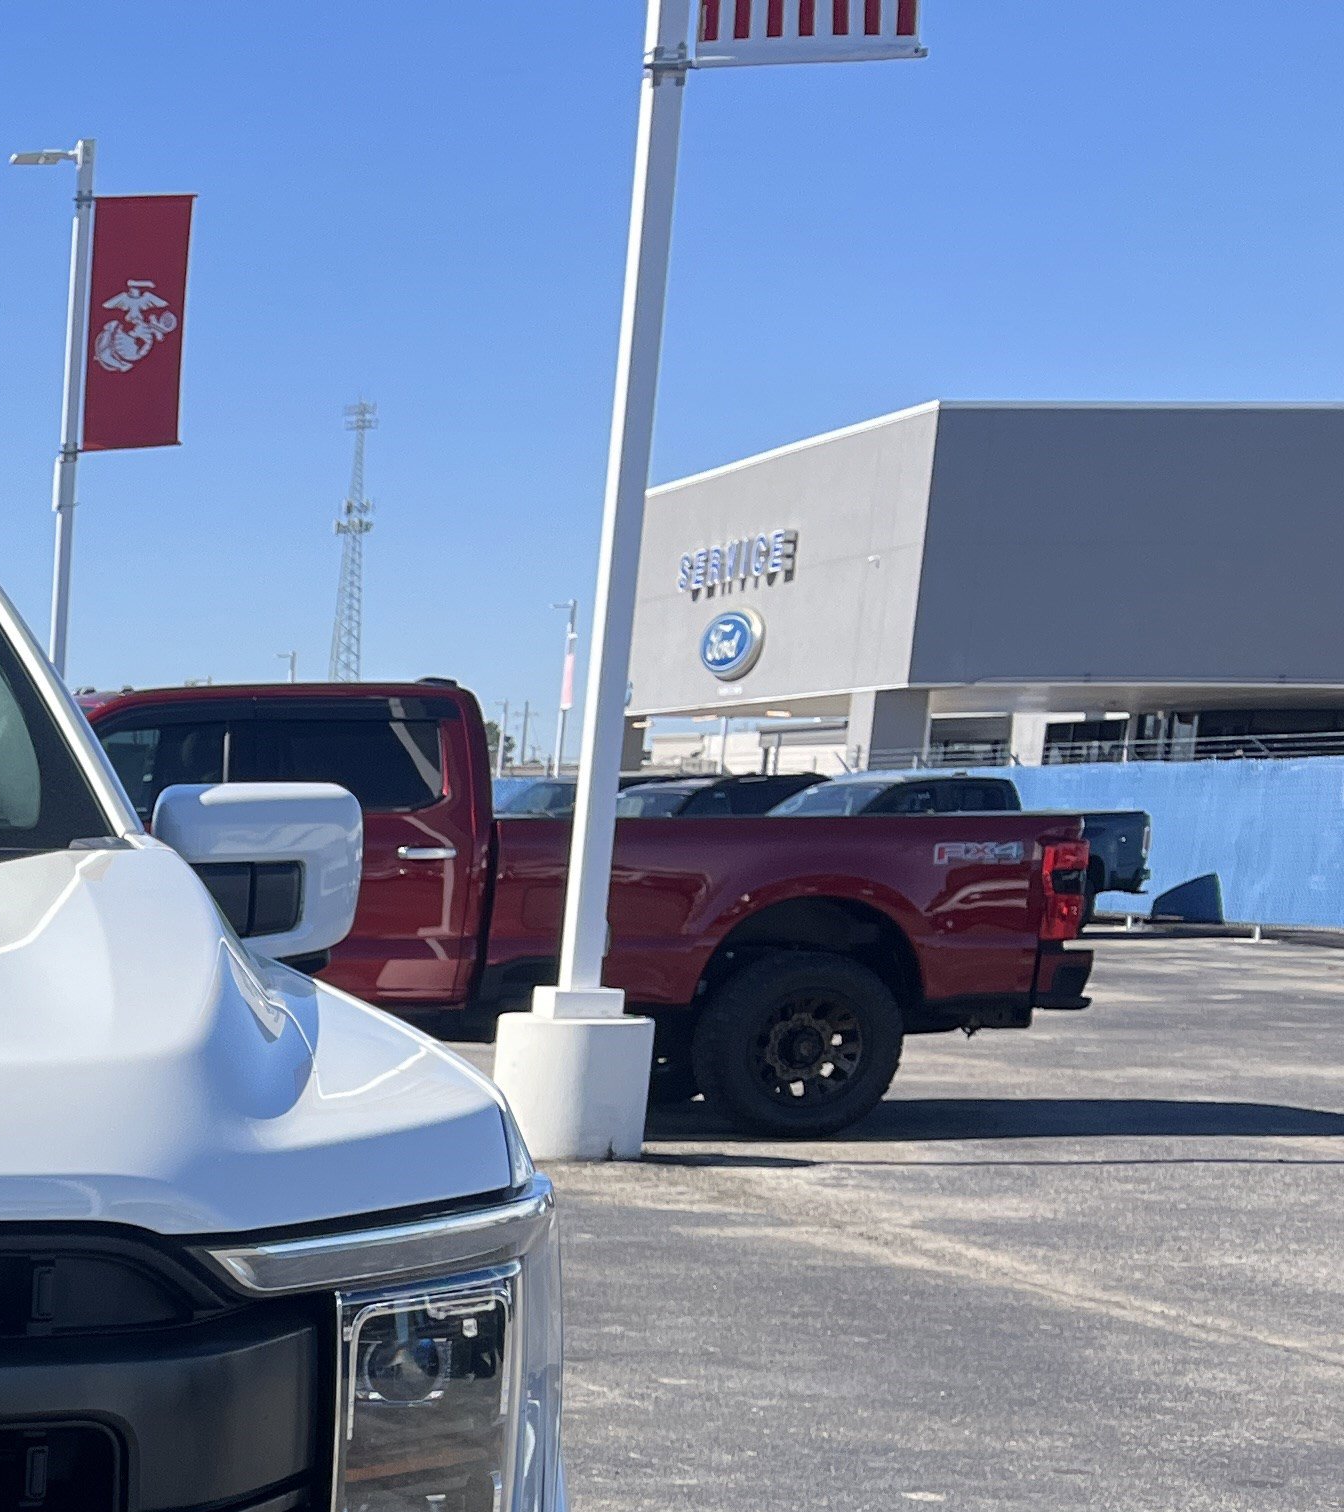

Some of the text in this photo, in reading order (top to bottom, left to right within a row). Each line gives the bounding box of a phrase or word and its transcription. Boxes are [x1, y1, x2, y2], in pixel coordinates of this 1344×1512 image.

[678, 529, 787, 592] SERVICE
[705, 623, 742, 661] Ford
[933, 841, 1024, 865] FX4
